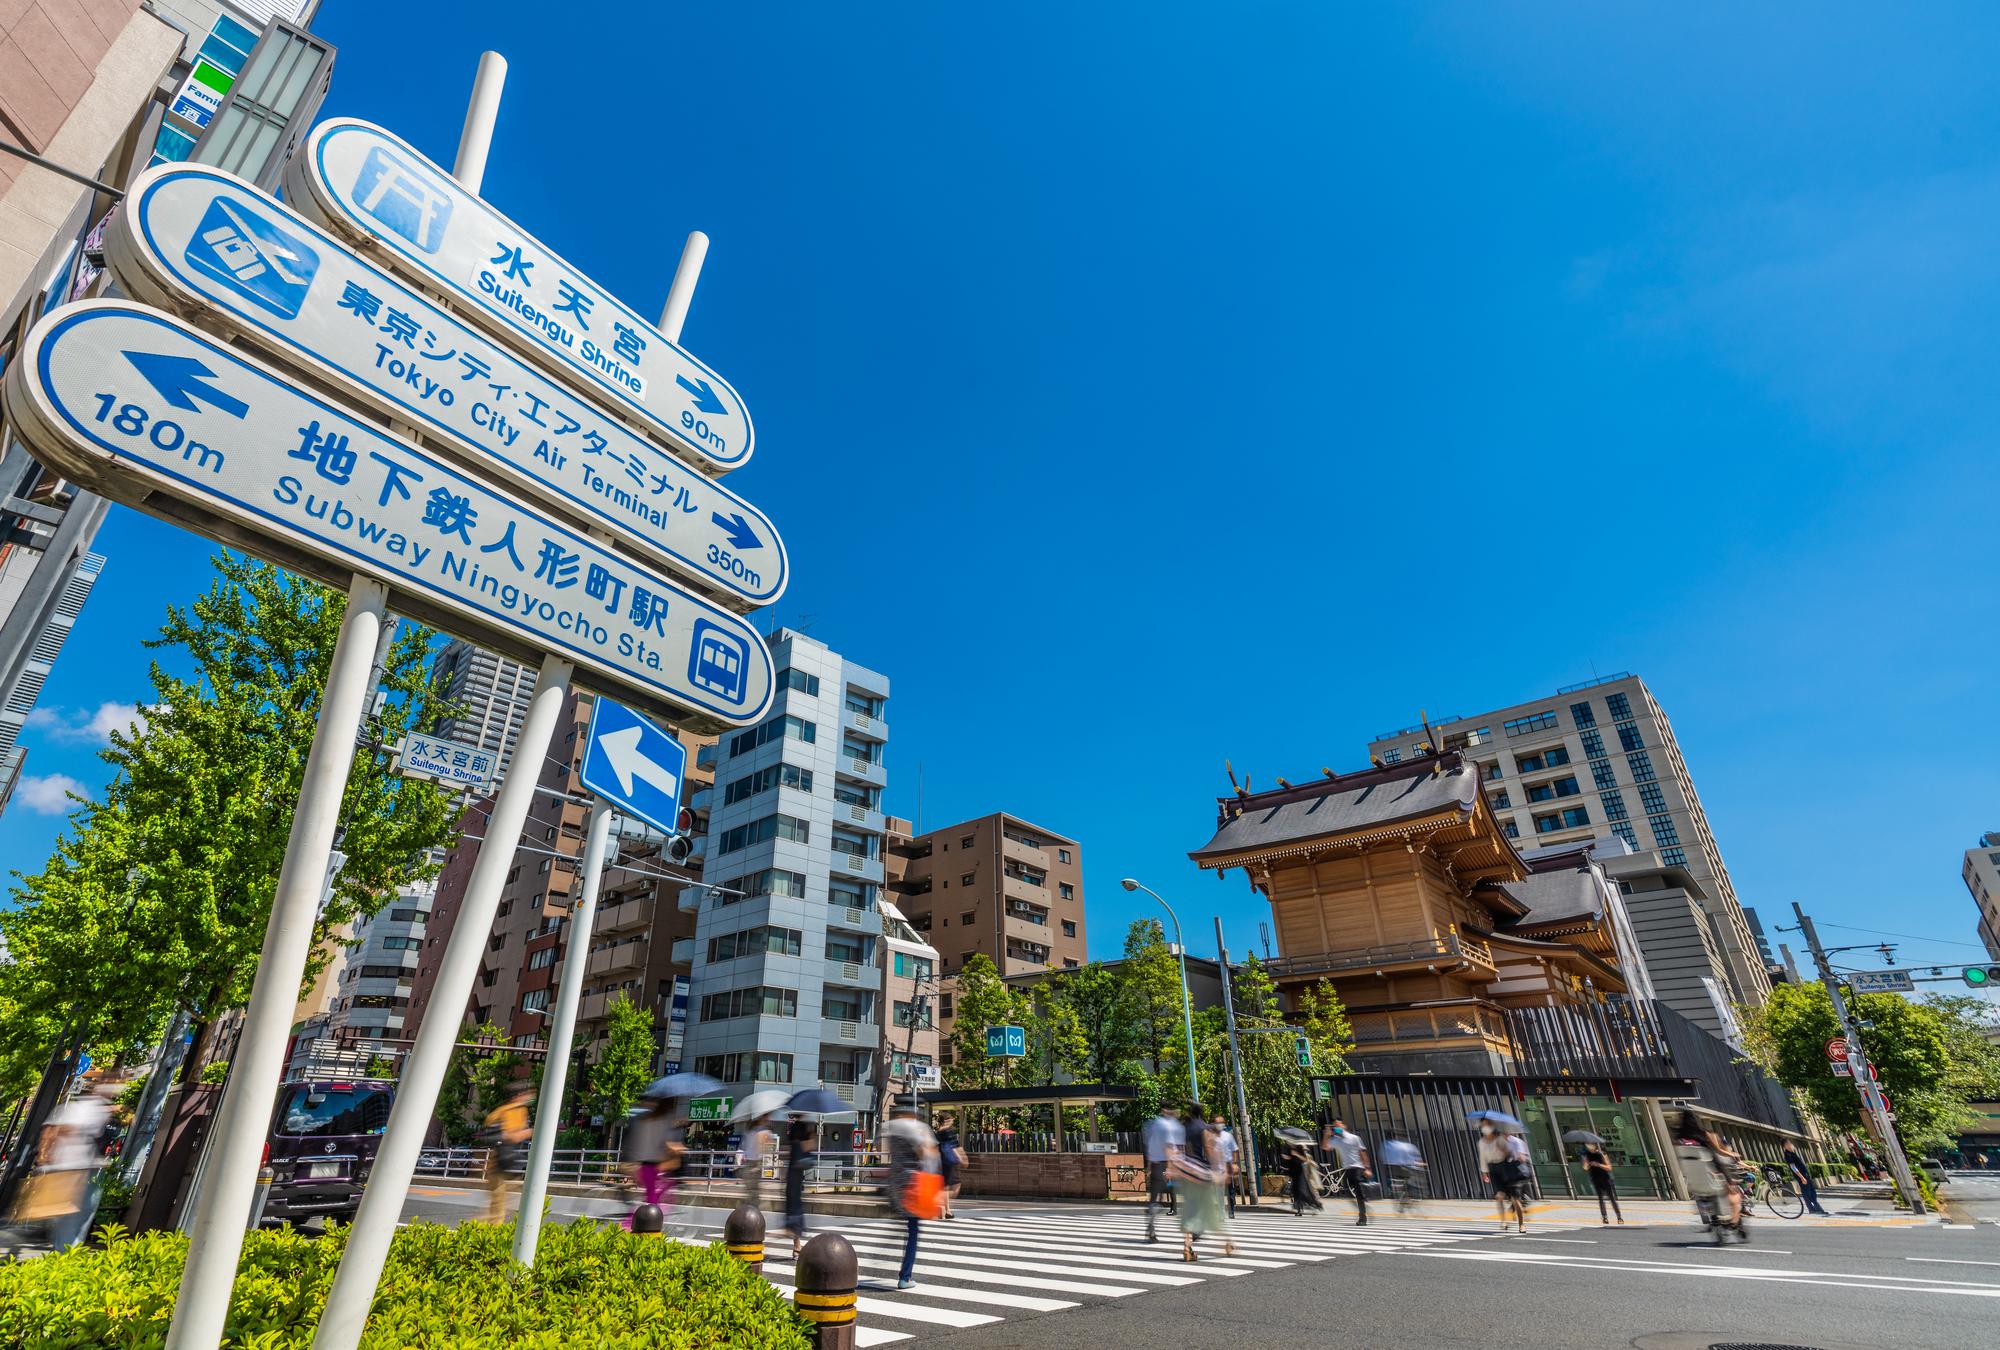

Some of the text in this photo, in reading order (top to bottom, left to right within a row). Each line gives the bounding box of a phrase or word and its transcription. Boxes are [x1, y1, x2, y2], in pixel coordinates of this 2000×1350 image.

[477, 270, 642, 394] Suitengu Shrine
[490, 241, 647, 366] 水天宮
[94, 392, 225, 474] 180m
[336, 279, 699, 514] 東京シティ・エアターミナル
[375, 342, 668, 530] Tokyo City Air Terminal
[681, 410, 726, 453] 90m
[273, 475, 664, 672] Subway Ningyocho Sta.
[287, 420, 669, 638] 地下鉄人形町駅
[707, 544, 762, 589] 350m
[410, 756, 482, 783] Suitengu Shrine
[411, 739, 489, 773] 水天宮前
[1855, 973, 1905, 984] 水天宮前
